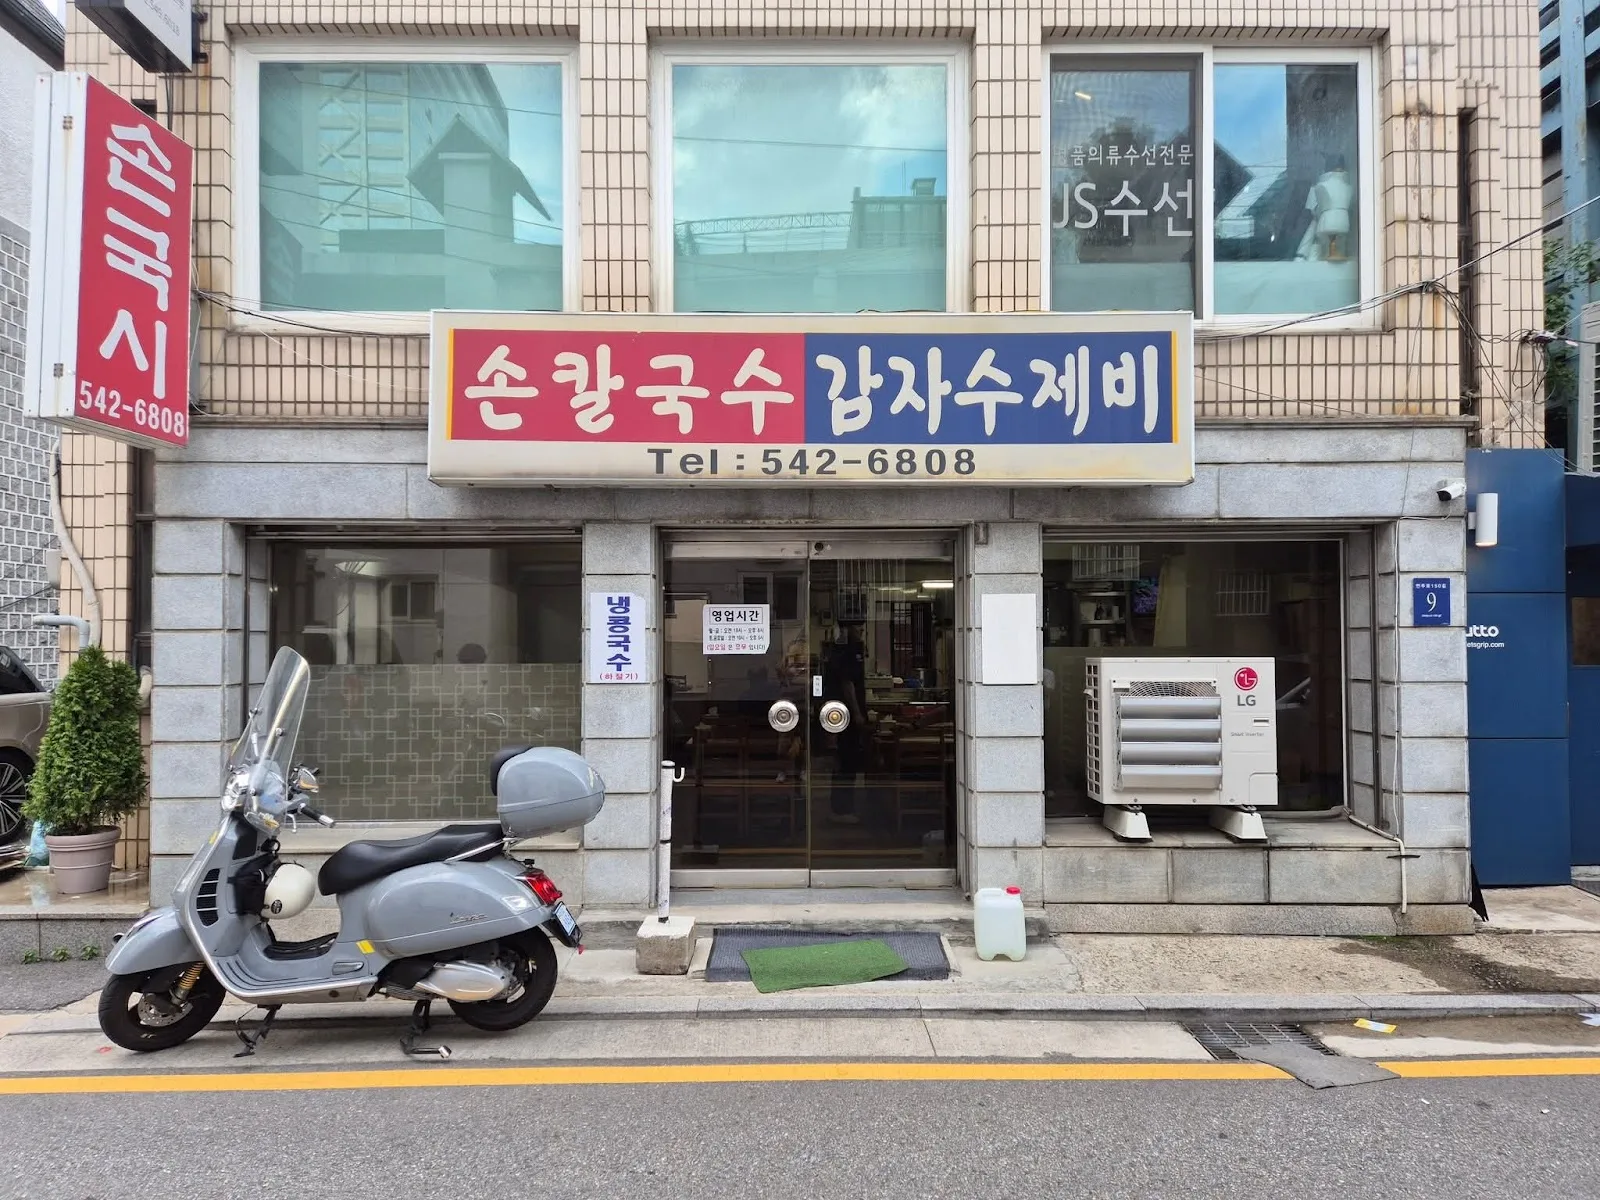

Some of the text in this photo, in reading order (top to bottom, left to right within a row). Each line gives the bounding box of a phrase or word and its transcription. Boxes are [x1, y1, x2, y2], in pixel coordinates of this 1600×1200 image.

[1053, 179, 1193, 237] JS수선
[99, 124, 176, 399] 손국시
[79, 380, 185, 438] 542-6808
[464, 344, 1158, 436] 손칼국수 감자수제비
[760, 448, 976, 475] 542-6808
[712, 611, 760, 622] 영업시간
[1427, 592, 1436, 612] 9
[606, 596, 632, 672] 냉콩국수
[1237, 695, 1256, 706] LG
